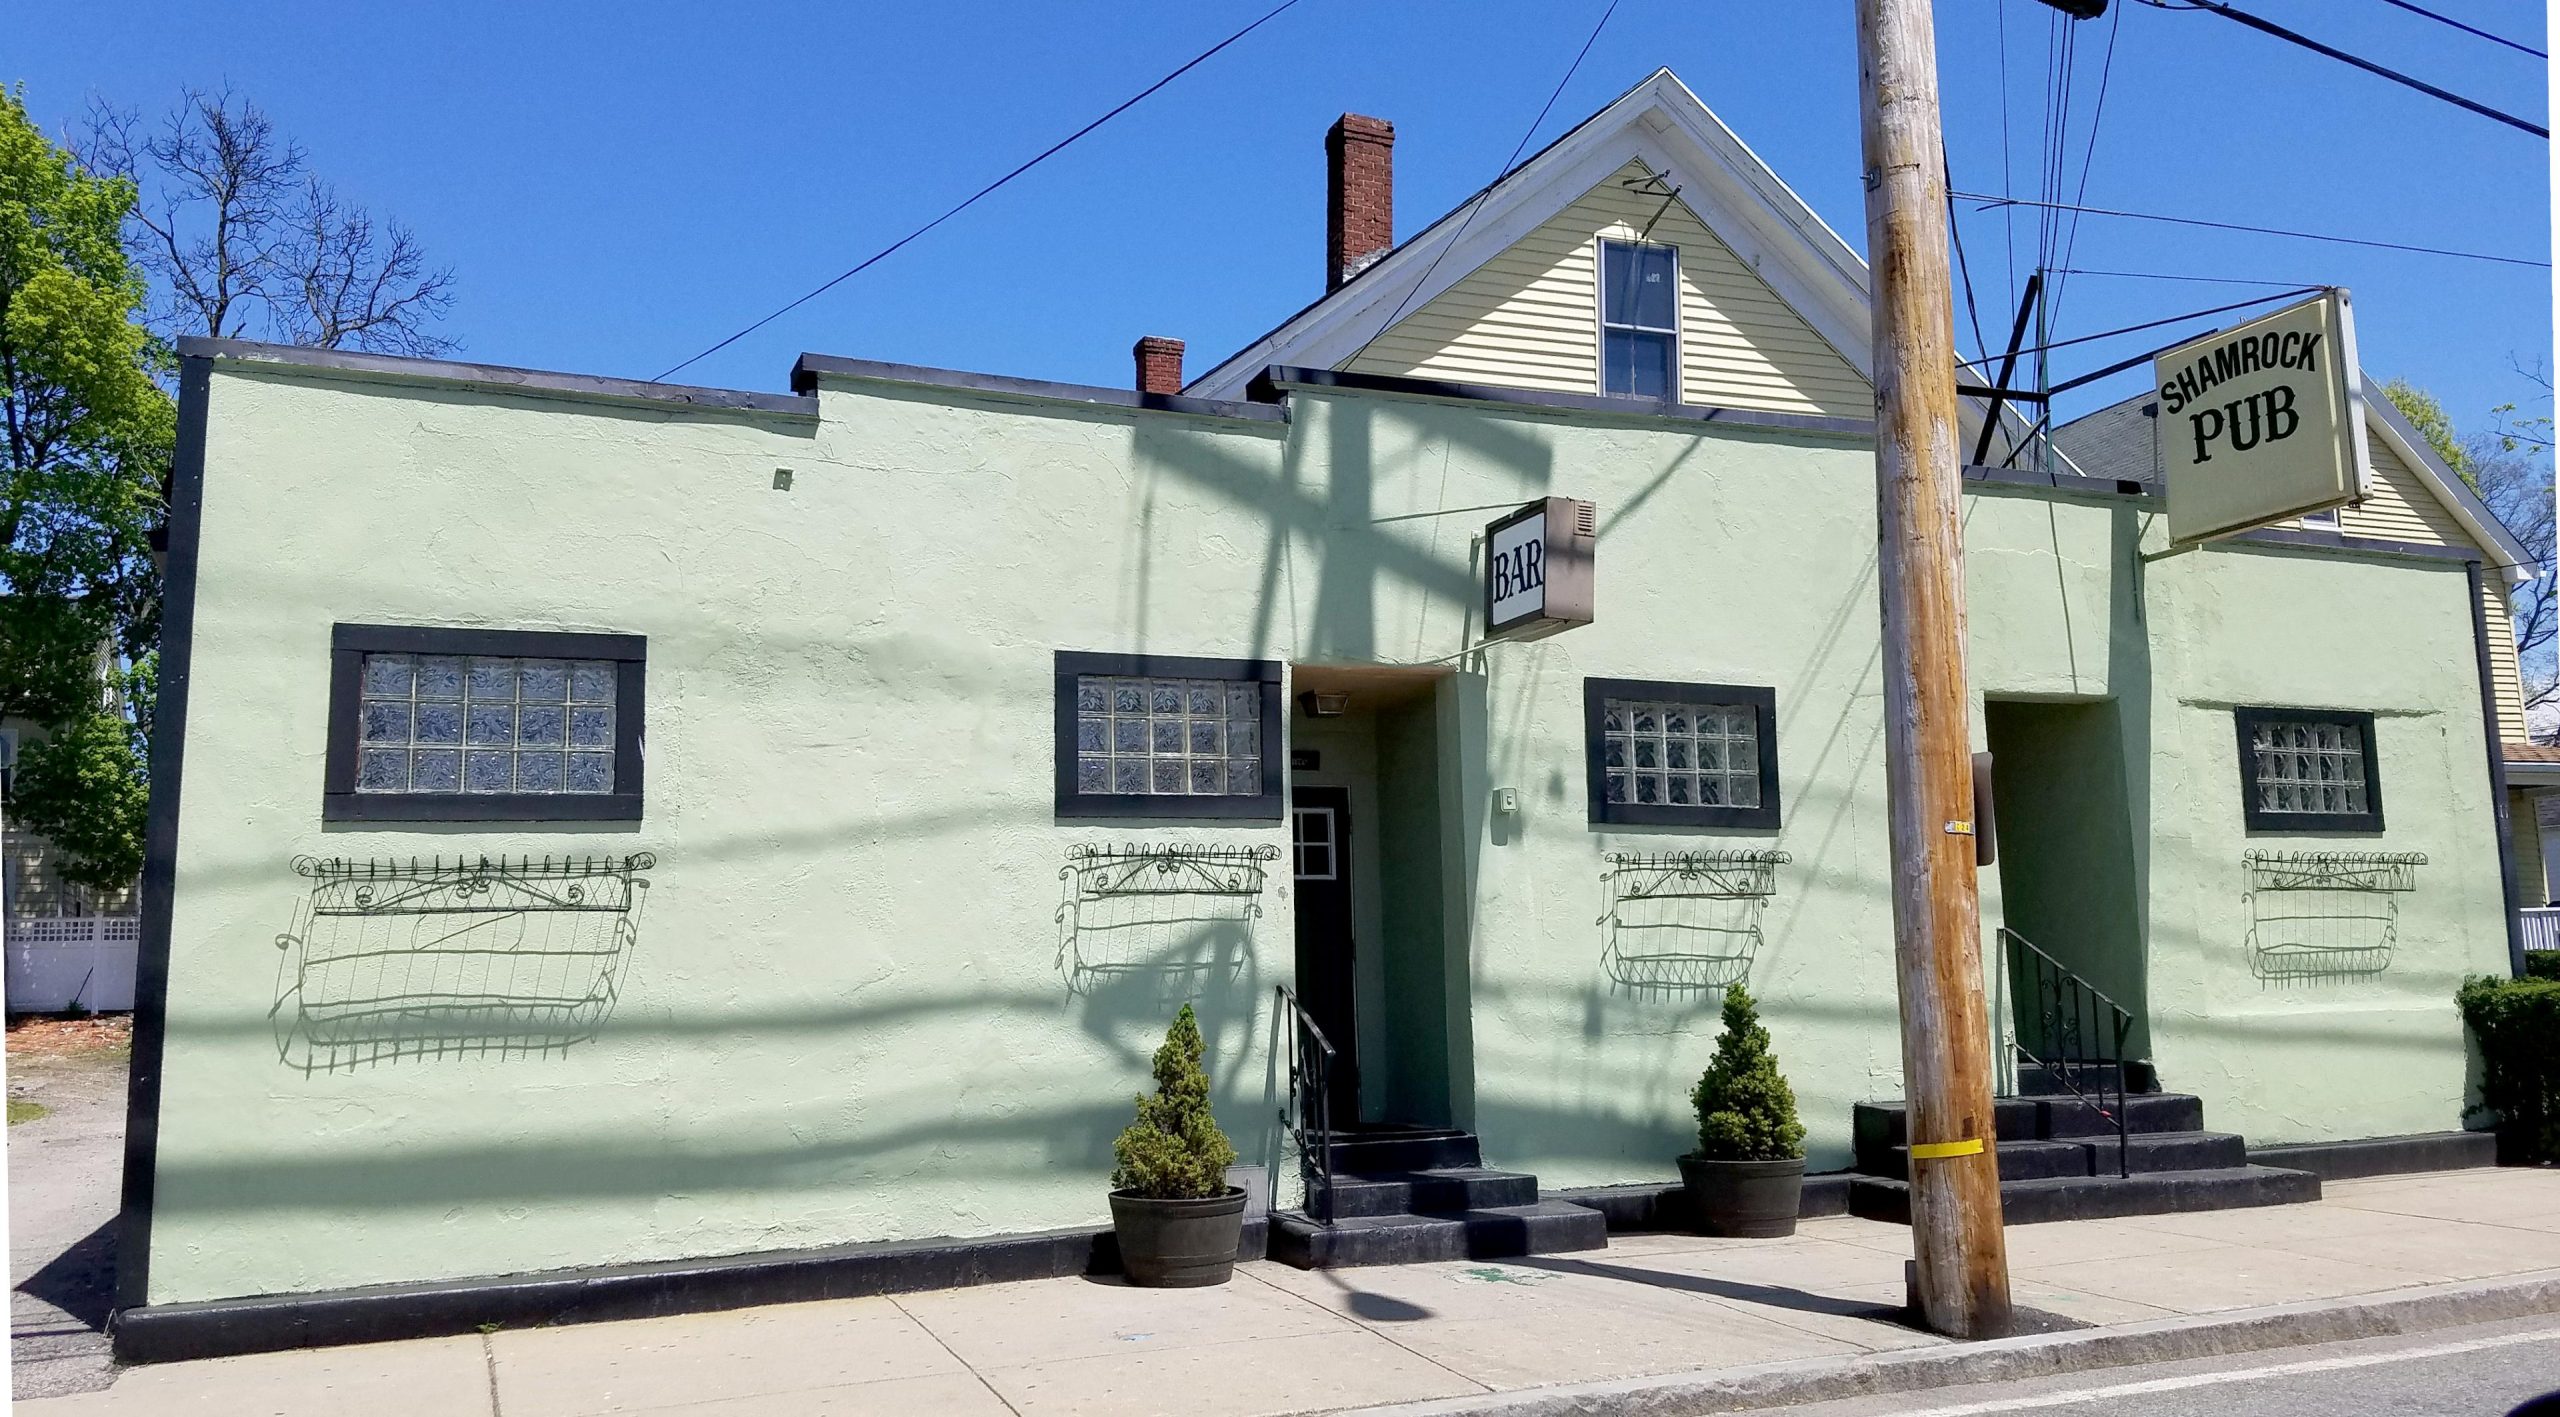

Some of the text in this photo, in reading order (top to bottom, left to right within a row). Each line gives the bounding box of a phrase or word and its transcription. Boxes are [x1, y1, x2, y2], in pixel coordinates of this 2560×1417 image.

[2160, 331, 2322, 414] SHAMROCK
[2189, 385, 2300, 464] PUB
[1494, 538, 1543, 604] BAR
